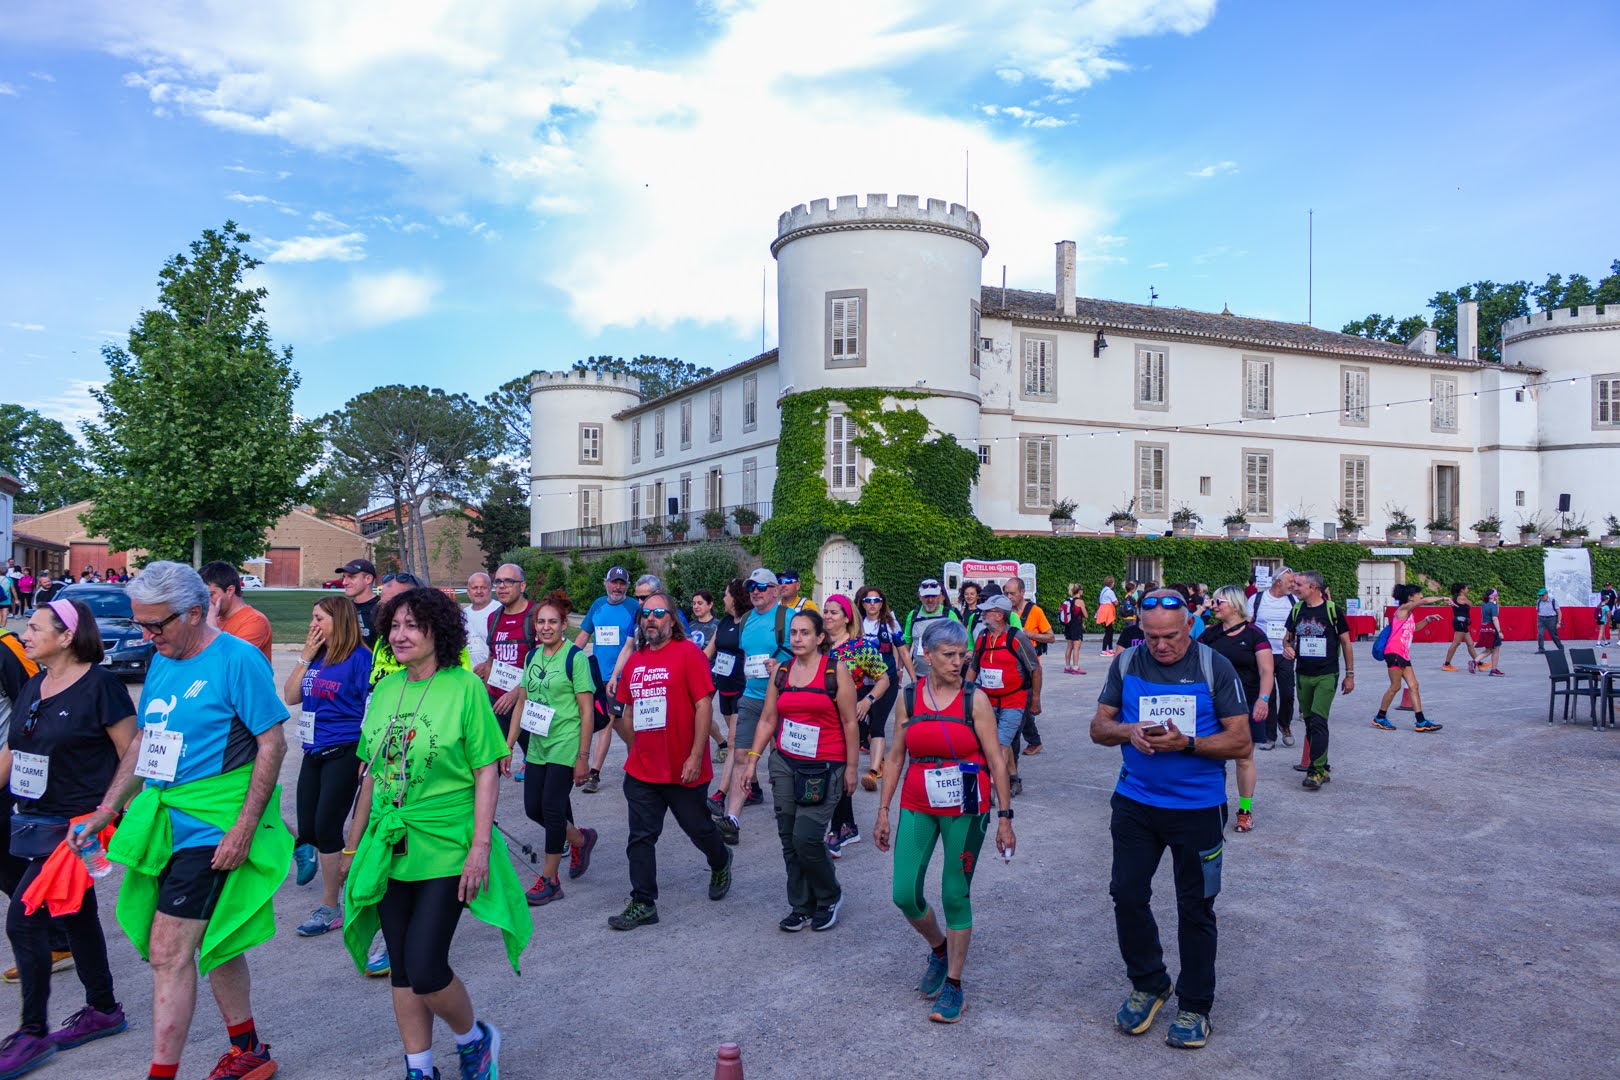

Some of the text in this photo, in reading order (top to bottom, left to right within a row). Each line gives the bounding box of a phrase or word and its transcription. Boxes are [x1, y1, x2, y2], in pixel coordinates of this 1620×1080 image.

[495, 644, 518, 660] HUB
[632, 673, 641, 682] 17
[526, 709, 547, 722] GEMMA
[640, 707, 660, 716] XAVIER
[1149, 707, 1186, 717] ALFONS
[789, 730, 807, 741] NEUS
[147, 743, 167, 756] JOAN
[22, 766, 44, 777] CARME
[947, 790, 960, 798] 712
